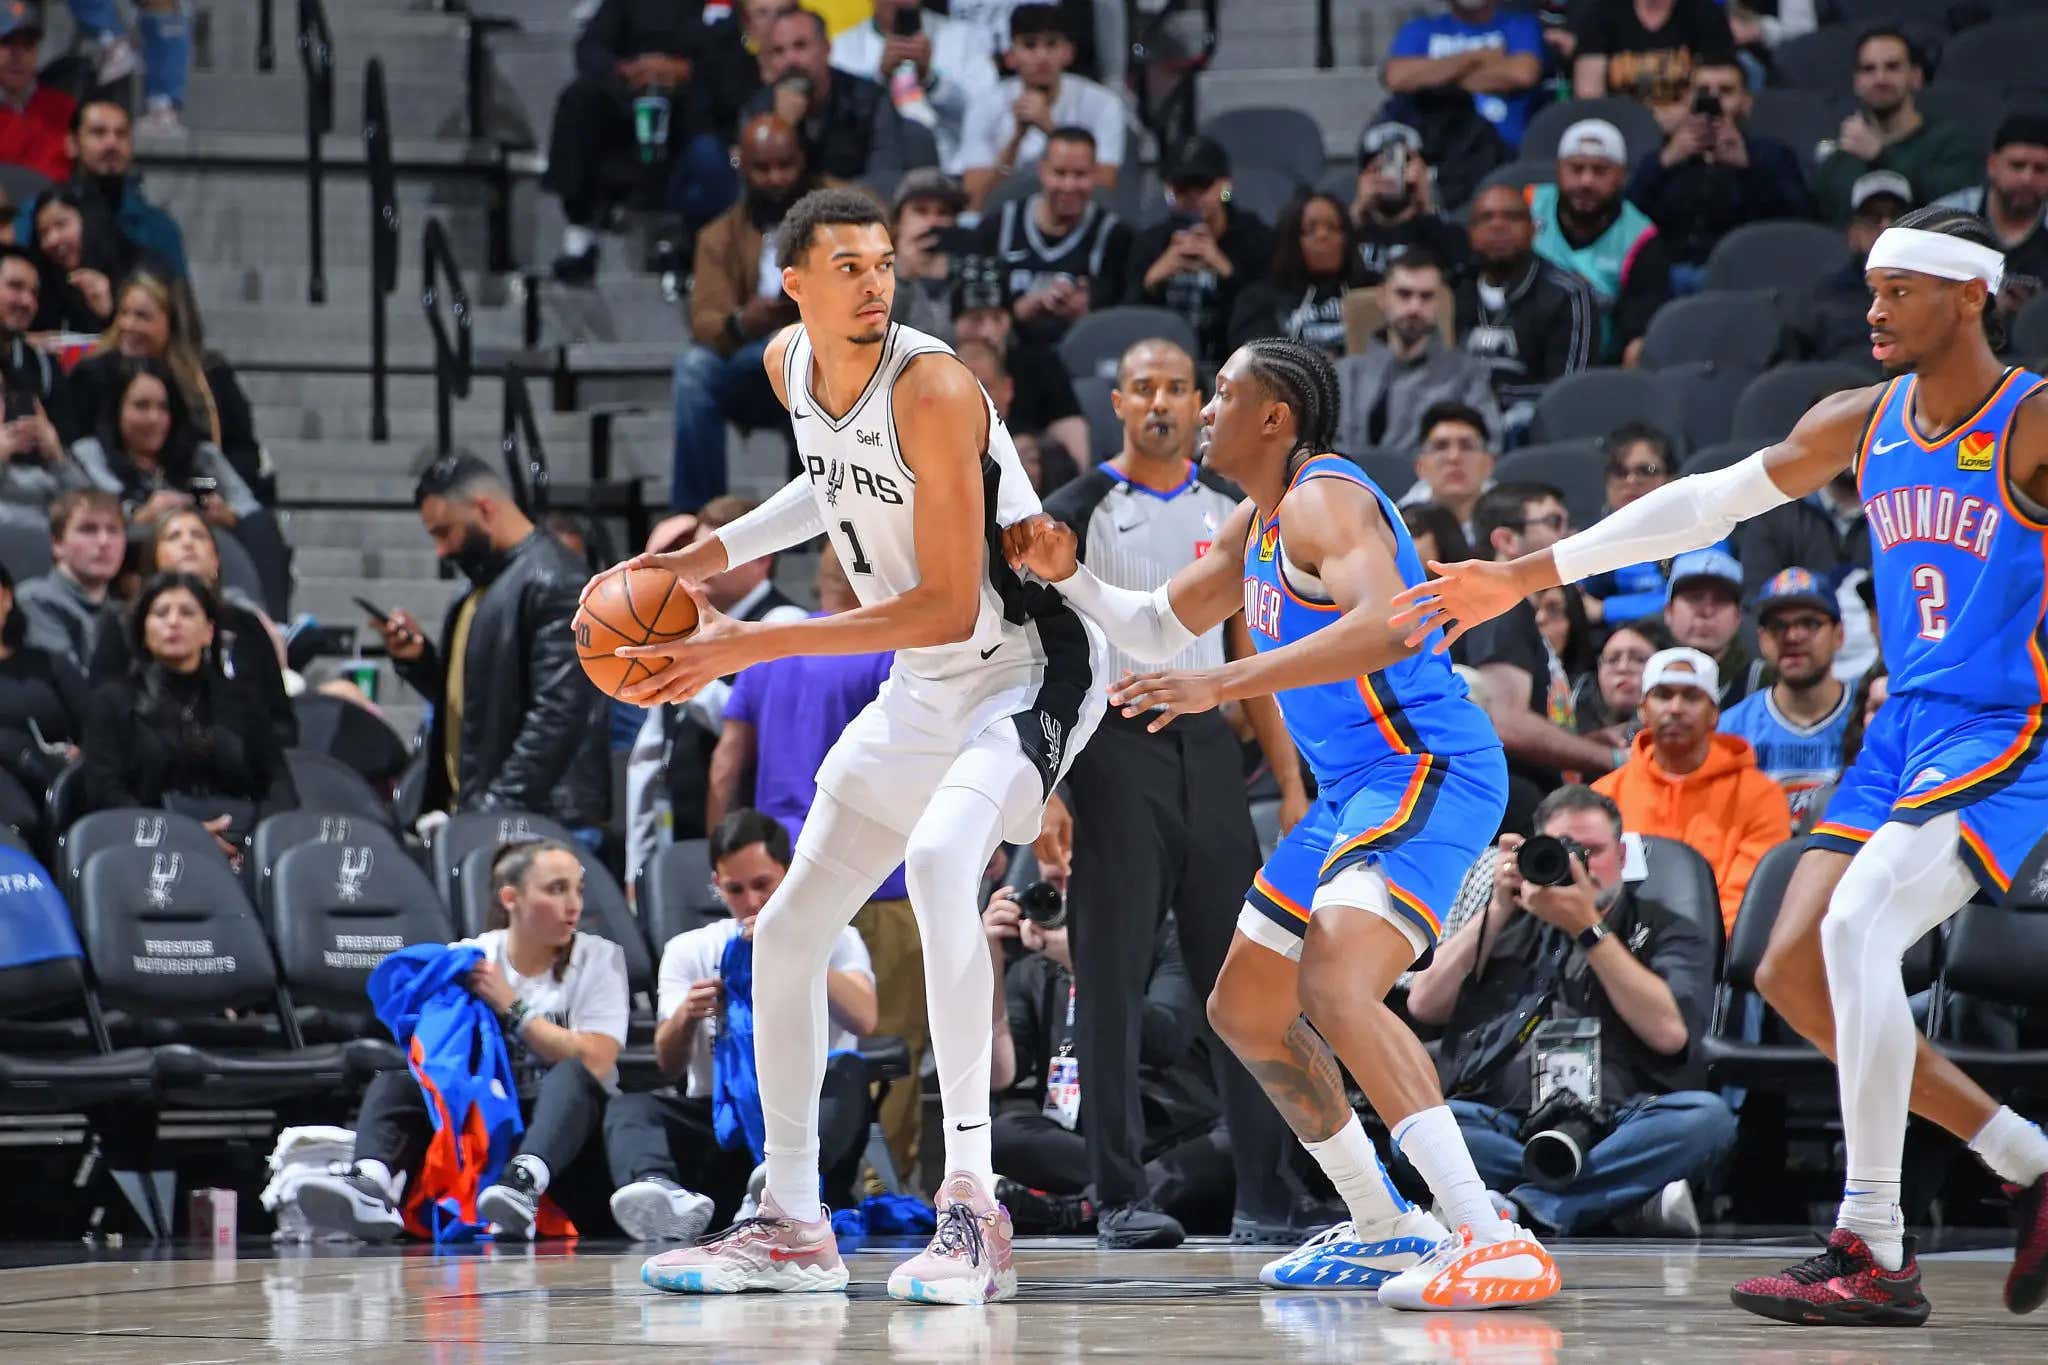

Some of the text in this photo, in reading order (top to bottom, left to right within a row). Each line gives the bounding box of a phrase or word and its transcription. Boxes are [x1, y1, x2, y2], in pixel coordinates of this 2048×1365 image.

[856, 428, 884, 447] Self.
[839, 519, 874, 576] 1
[1864, 486, 2000, 560] THUNDER
[1912, 564, 1947, 642] 2
[0, 872, 45, 894] TRA
